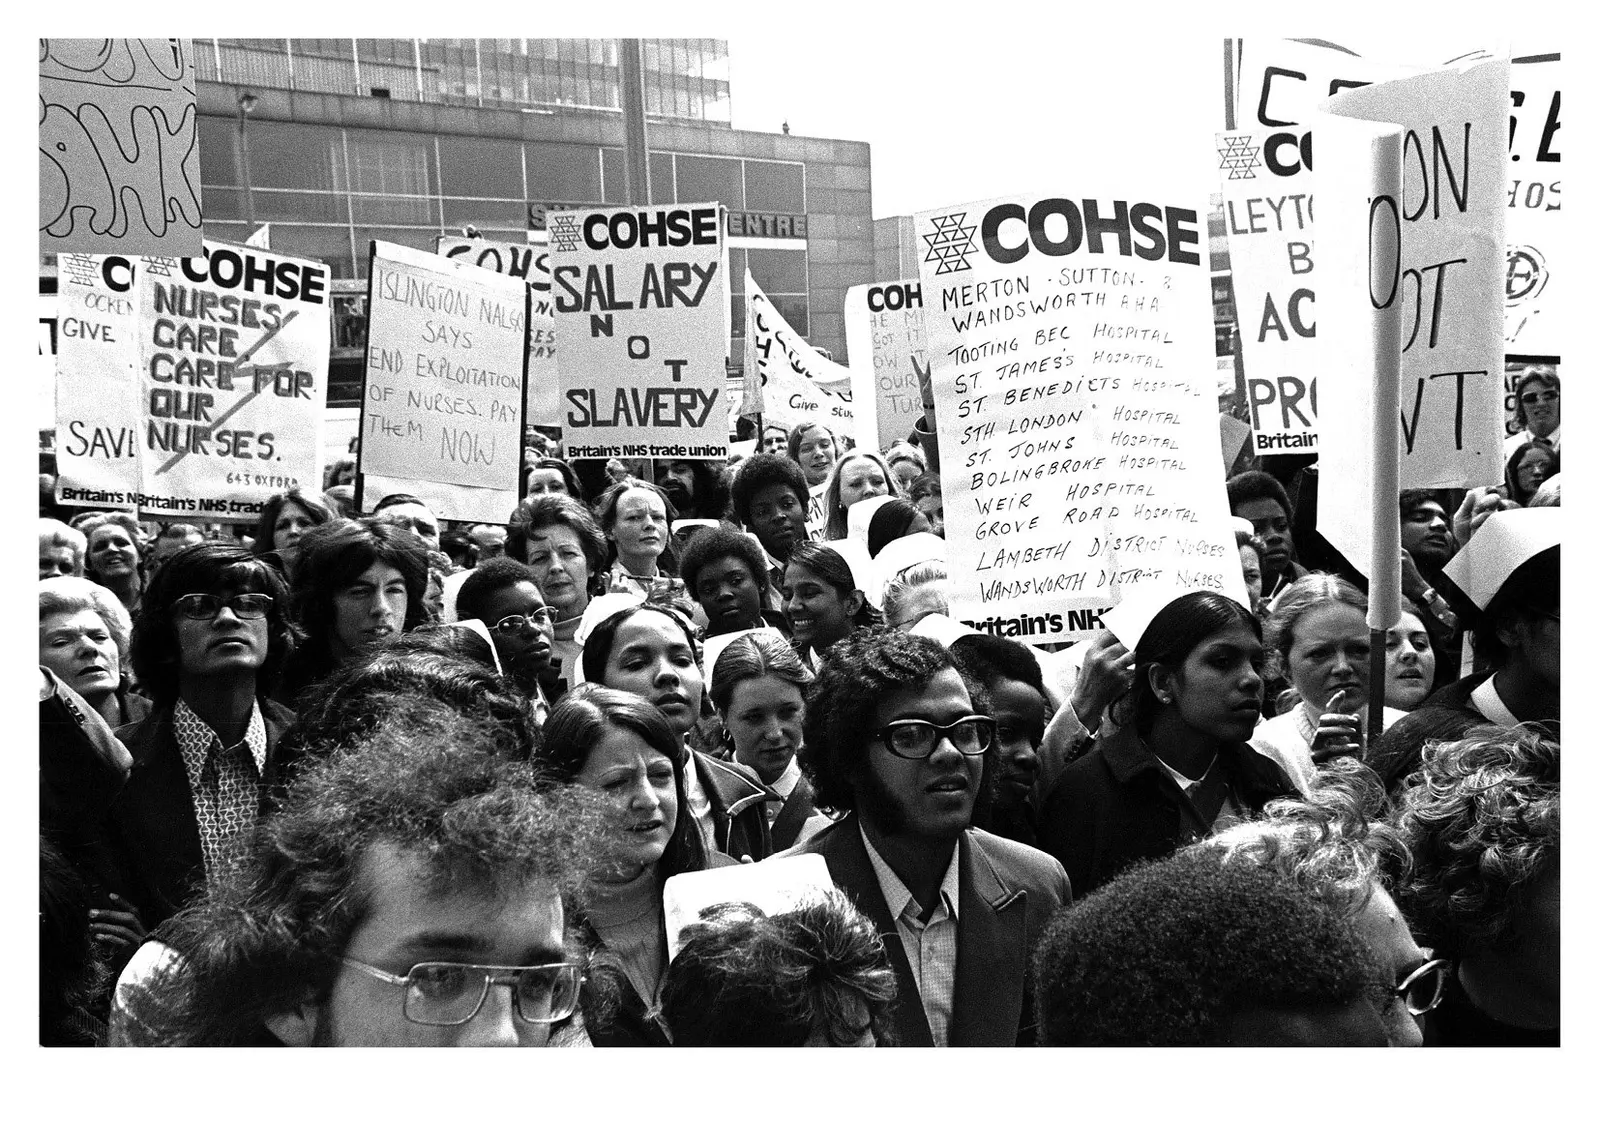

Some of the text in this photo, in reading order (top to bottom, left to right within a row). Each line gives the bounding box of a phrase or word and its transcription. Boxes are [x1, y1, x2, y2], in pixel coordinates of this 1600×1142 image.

[583, 208, 718, 250] COHSE
[981, 197, 1201, 266] COHSE
[1228, 193, 1314, 235] LEYT
[180, 246, 325, 305] COHSE
[378, 269, 469, 318] ISLINGTON
[553, 261, 718, 313] SALARY
[943, 275, 1030, 312] MERTON
[153, 281, 282, 332] NURSES
[951, 292, 1106, 333] WANDSWORTH
[62, 317, 117, 344] GIVE
[152, 317, 240, 358] CARE
[421, 320, 473, 350] SAYS
[948, 322, 1173, 366] TOOTING BEC HOSPITAL
[150, 352, 237, 392] CARE
[368, 345, 521, 392] END EXPLOITATION
[1093, 350, 1164, 369] HOSPITAL
[149, 387, 215, 423] OUR
[369, 384, 395, 403] OF
[490, 400, 518, 424] PAY
[566, 387, 719, 428] SLAVERY
[788, 393, 819, 411] Give
[1007, 410, 1083, 435] LONDON
[1113, 405, 1181, 426] HOSPITAL
[1247, 375, 1318, 431] PR
[441, 427, 496, 466] NOW
[568, 444, 727, 458] Britain's NHS trade union
[1008, 436, 1076, 459] JOHNS
[1110, 430, 1180, 450] HOSPITAL
[226, 472, 251, 486] 643
[970, 454, 1188, 491] BOLINGBROKE HOSPITAL
[62, 487, 124, 505] Britain's
[975, 482, 1156, 515] WEIR HOSPITAL
[975, 503, 1199, 540] GROVE ROAD HOSPITAL
[975, 541, 1072, 571] LAMBETH
[1087, 532, 1168, 558] DISTRICT
[979, 571, 1087, 603] WANDSWORTH
[959, 613, 1064, 638] ritain's
